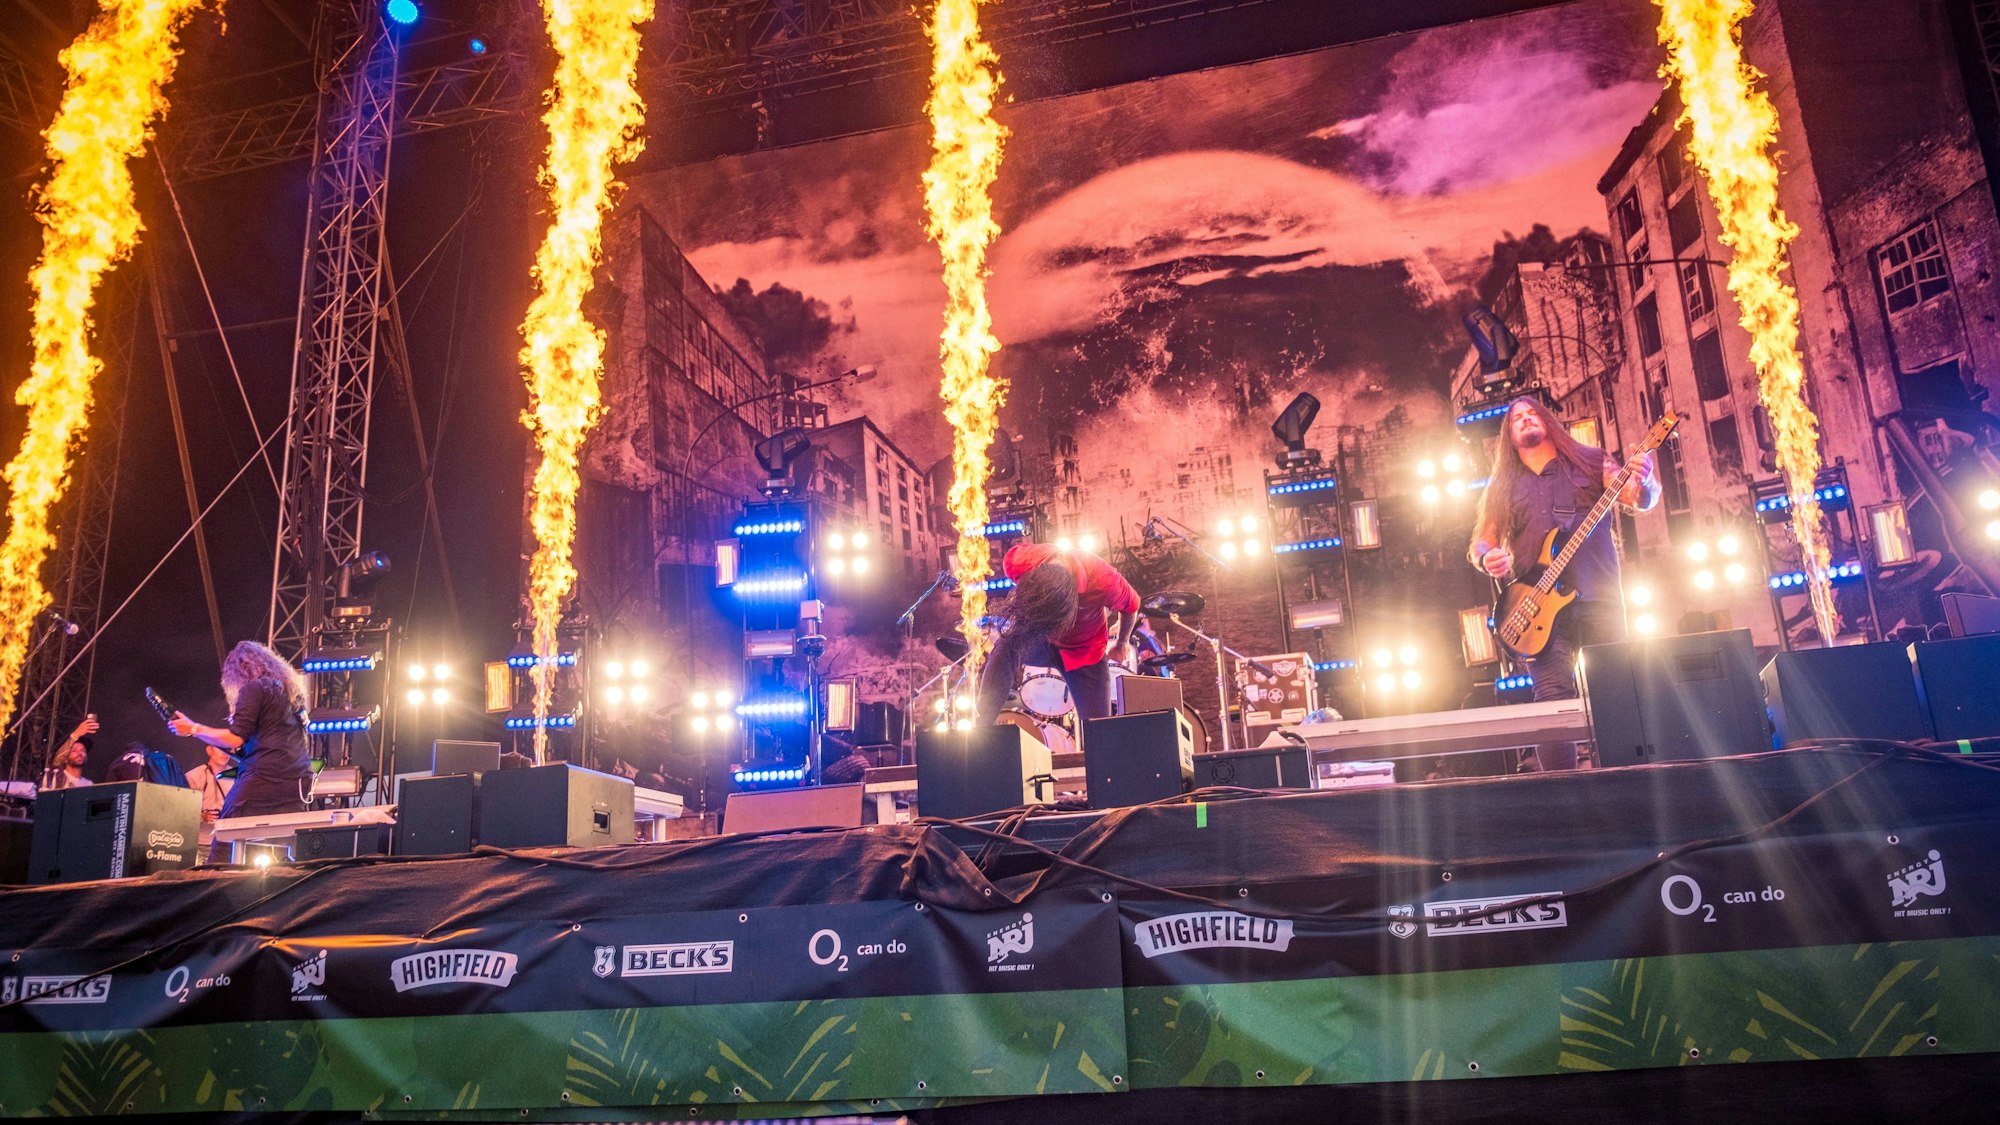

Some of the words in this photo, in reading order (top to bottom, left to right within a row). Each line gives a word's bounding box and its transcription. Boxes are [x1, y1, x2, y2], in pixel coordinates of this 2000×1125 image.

[146, 849, 182, 862] G-Flame
[1886, 858, 1928, 880] ENERGY
[1888, 849, 1946, 907] NRJ
[1723, 890, 1757, 904] can
[1761, 885, 1785, 902] do
[1432, 899, 1561, 929] BECKS
[1906, 909, 1929, 917] MUSIC
[987, 912, 1034, 963] NRJ
[1148, 916, 1279, 949] HIGHFIELD
[628, 943, 729, 971] BECK'S
[856, 943, 883, 956] can
[886, 939, 907, 954] do
[195, 976, 214, 988] can
[215, 973, 231, 987] do
[402, 953, 507, 985] HIGHFIELD
